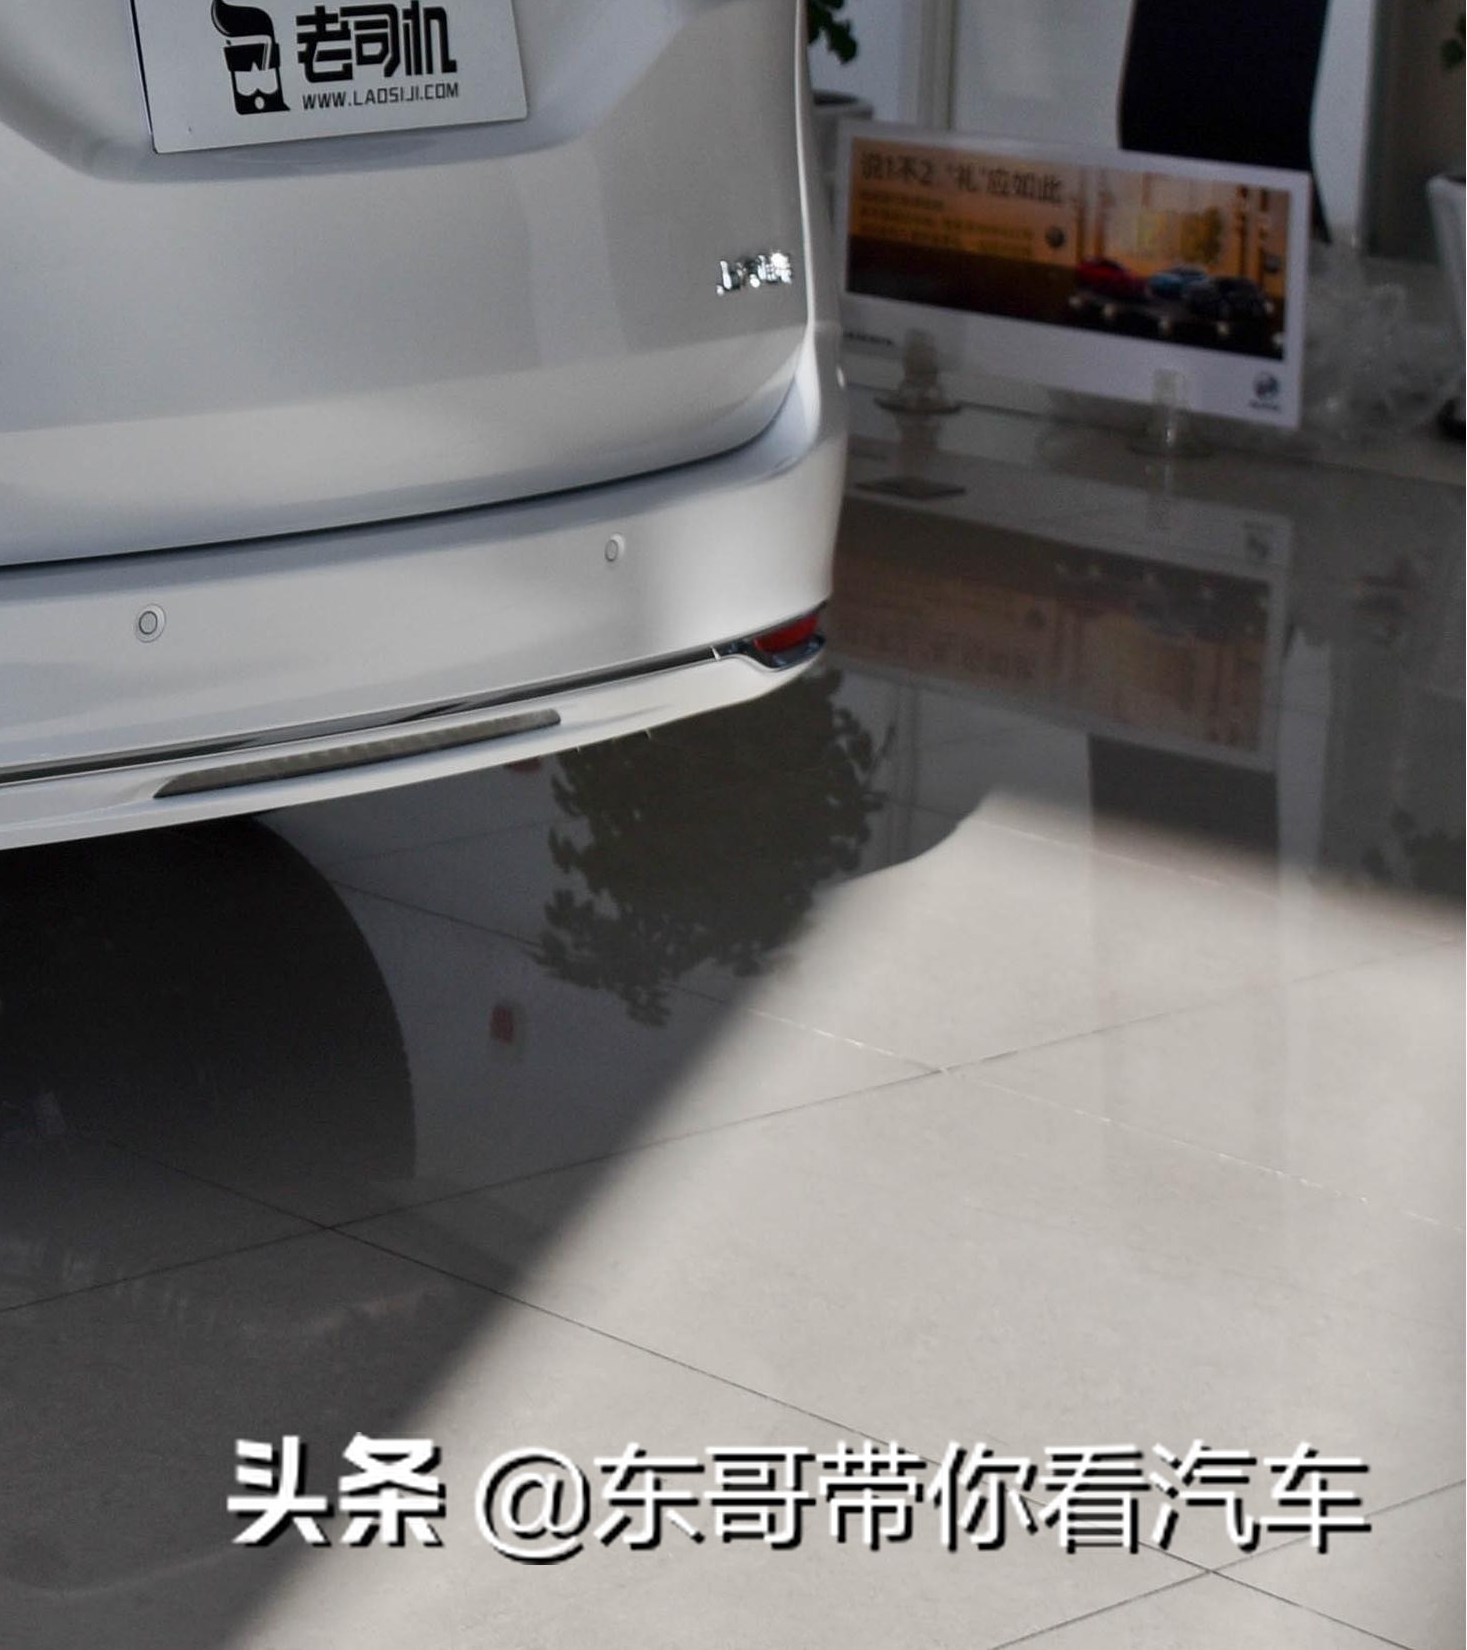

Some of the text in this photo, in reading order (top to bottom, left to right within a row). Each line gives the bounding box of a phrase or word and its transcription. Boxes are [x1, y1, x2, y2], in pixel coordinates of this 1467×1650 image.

[296, 0, 458, 83] 老司机
[302, 82, 460, 111] WWW.LAOSIJI.COM
